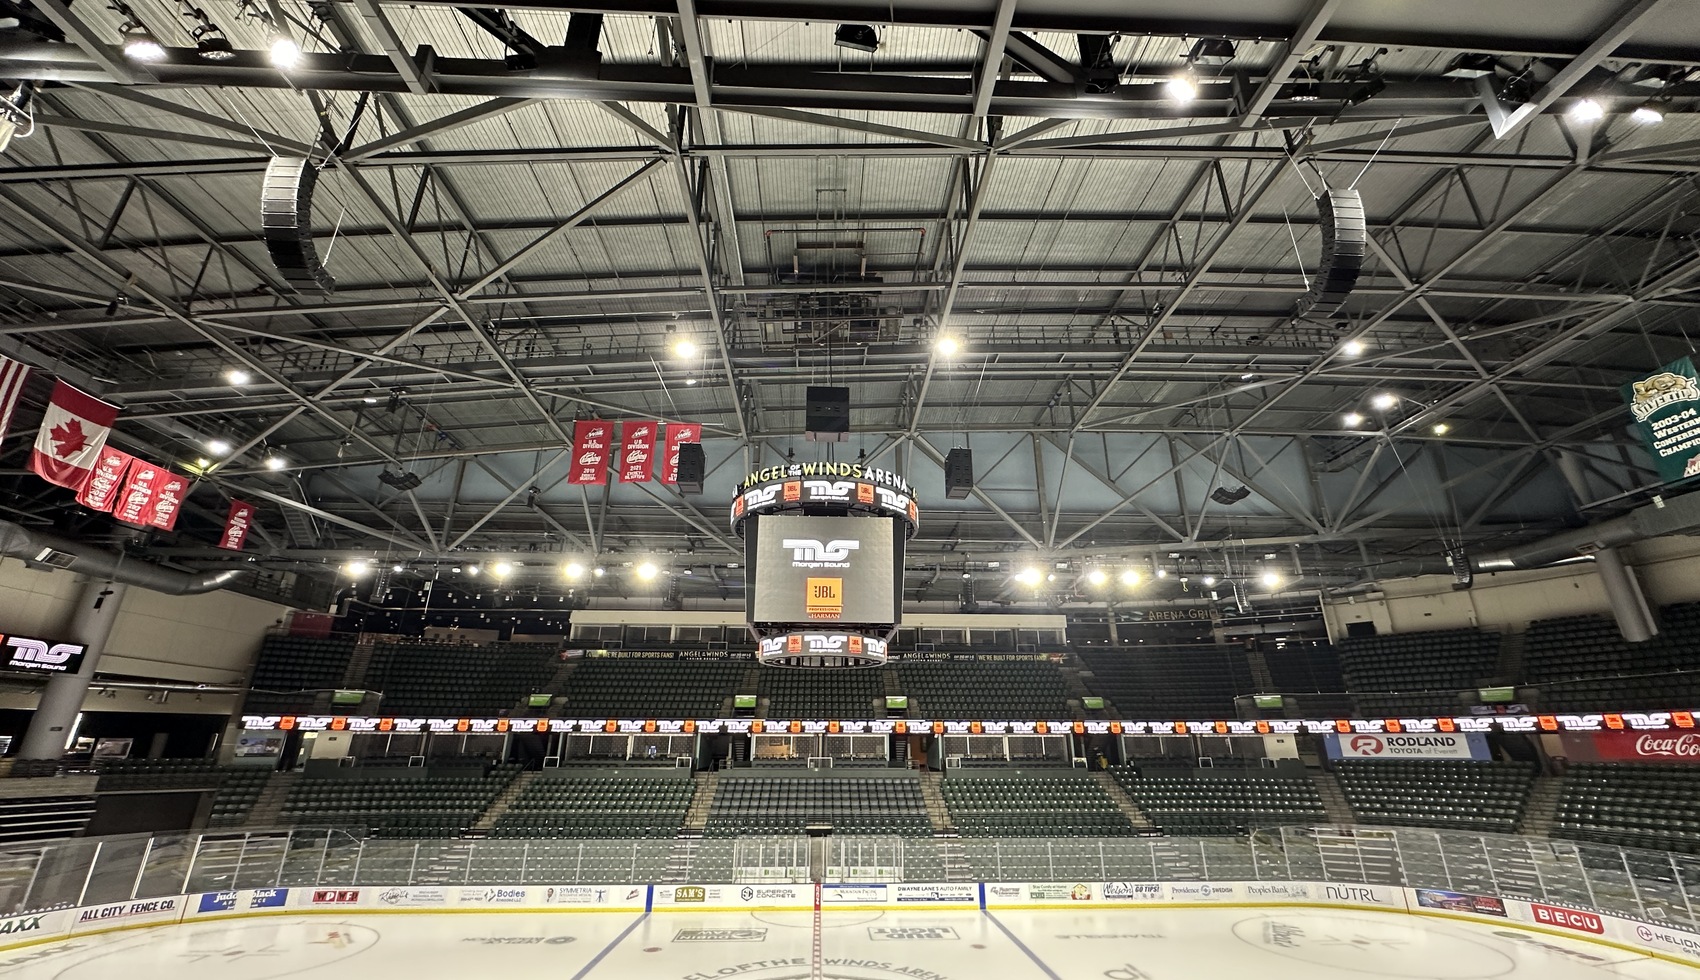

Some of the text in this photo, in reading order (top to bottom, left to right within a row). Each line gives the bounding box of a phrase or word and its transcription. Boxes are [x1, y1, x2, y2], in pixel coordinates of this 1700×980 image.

[1651, 408, 1697, 431] 2003-04
[744, 465, 787, 488] ANGEL
[803, 462, 862, 478] WINDS
[864, 466, 907, 492] ARENA
[814, 586, 835, 598] JBL
[1149, 610, 1185, 620] ARENA
[1386, 737, 1456, 746] RODLAND
[1636, 734, 1700, 756] Coca-Co
[676, 889, 704, 898] SAM'S
[1106, 882, 1132, 894] Nelson
[1248, 886, 1288, 895] Peoples Bank
[81, 900, 175, 921] ALL CITY FENCE CO.
[0, 914, 47, 934] AXX
[823, 958, 892, 970] WINDS
